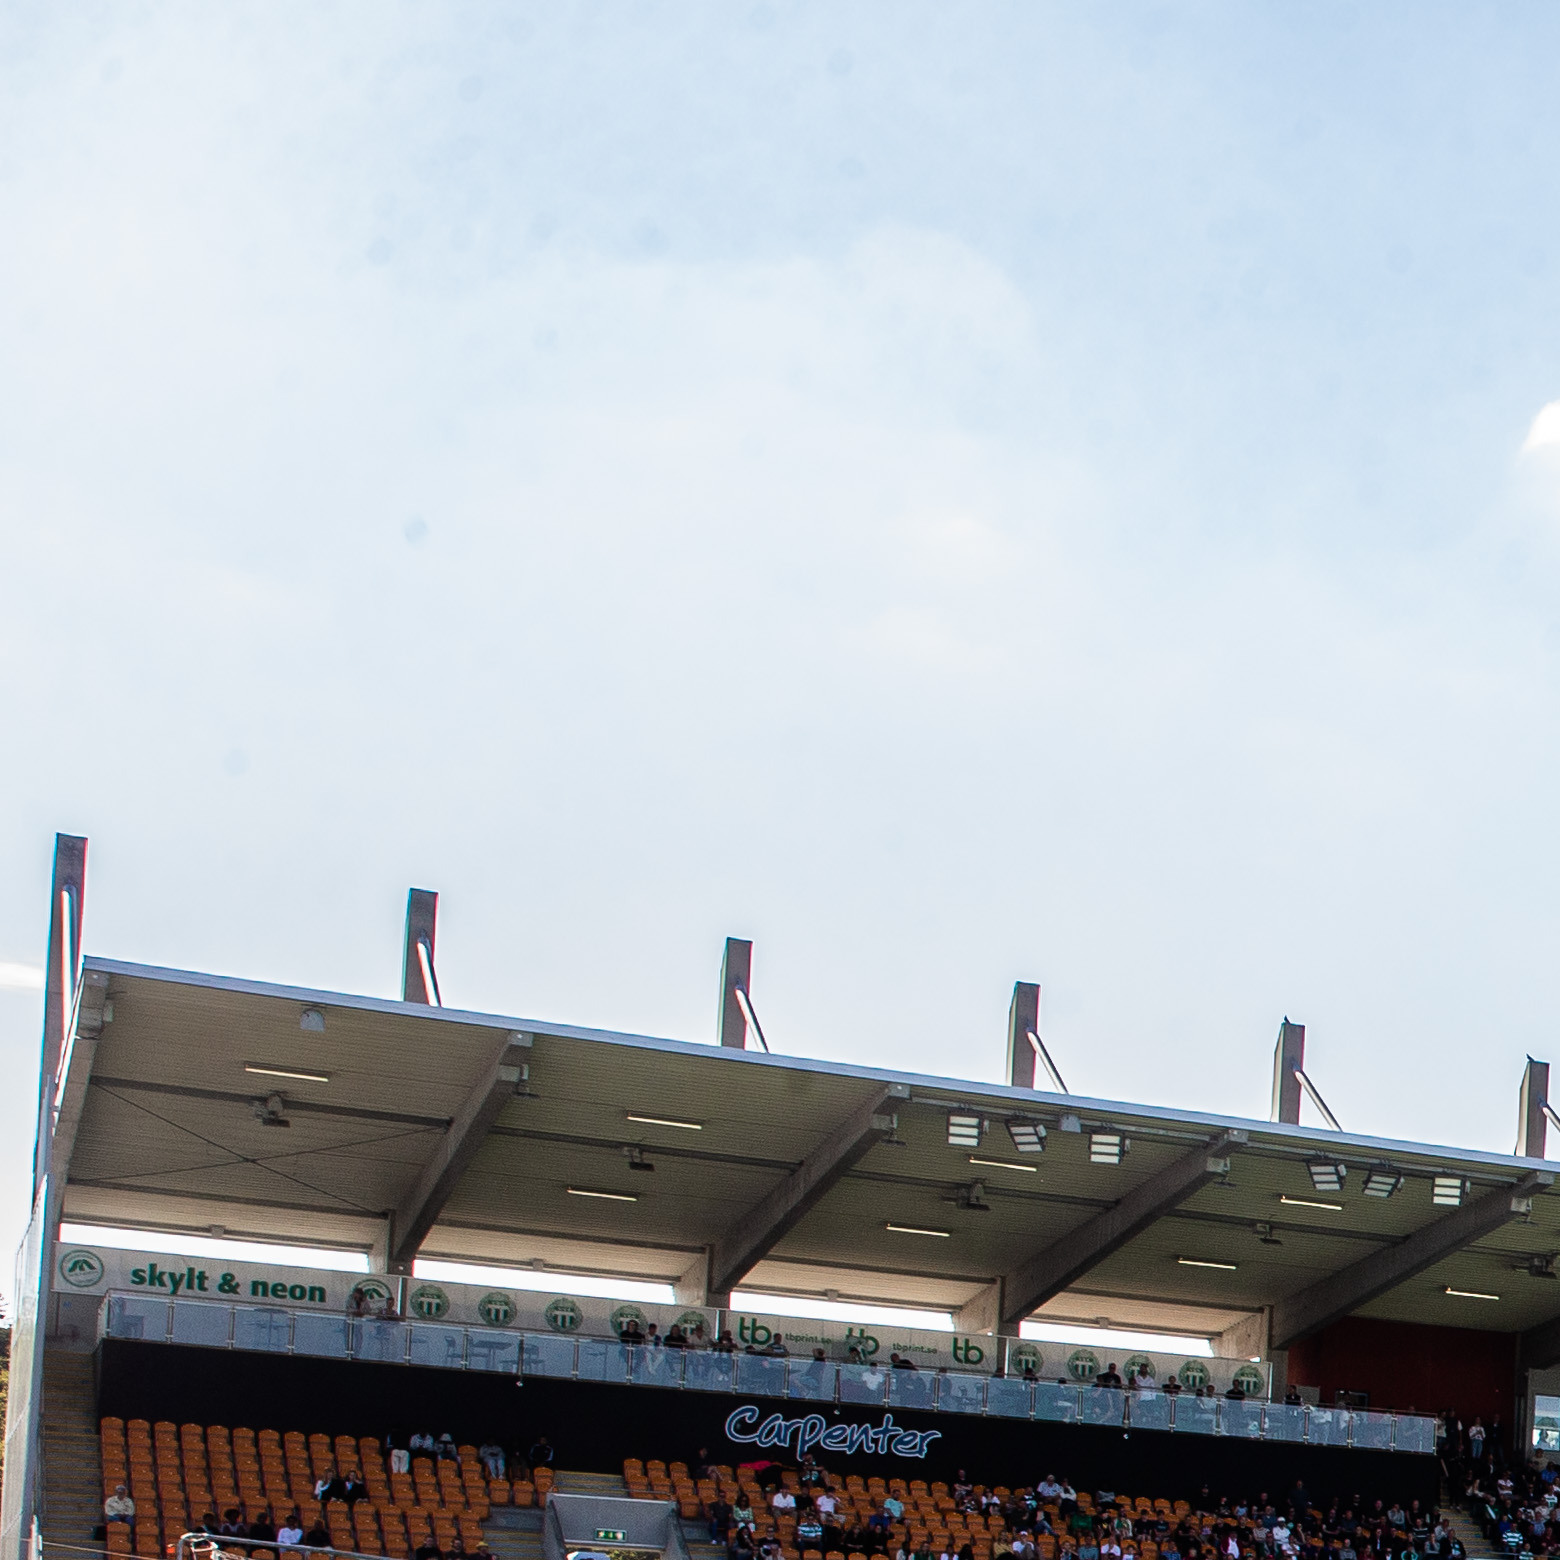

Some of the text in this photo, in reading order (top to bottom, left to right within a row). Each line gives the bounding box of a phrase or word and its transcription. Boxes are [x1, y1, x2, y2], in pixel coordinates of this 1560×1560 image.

[130, 1263, 209, 1294] skylt
[217, 1272, 240, 1295] &
[250, 1279, 327, 1303] neon
[738, 1316, 772, 1346] tb
[952, 1337, 984, 1365] tb
[725, 1405, 942, 1462] Carpenter
